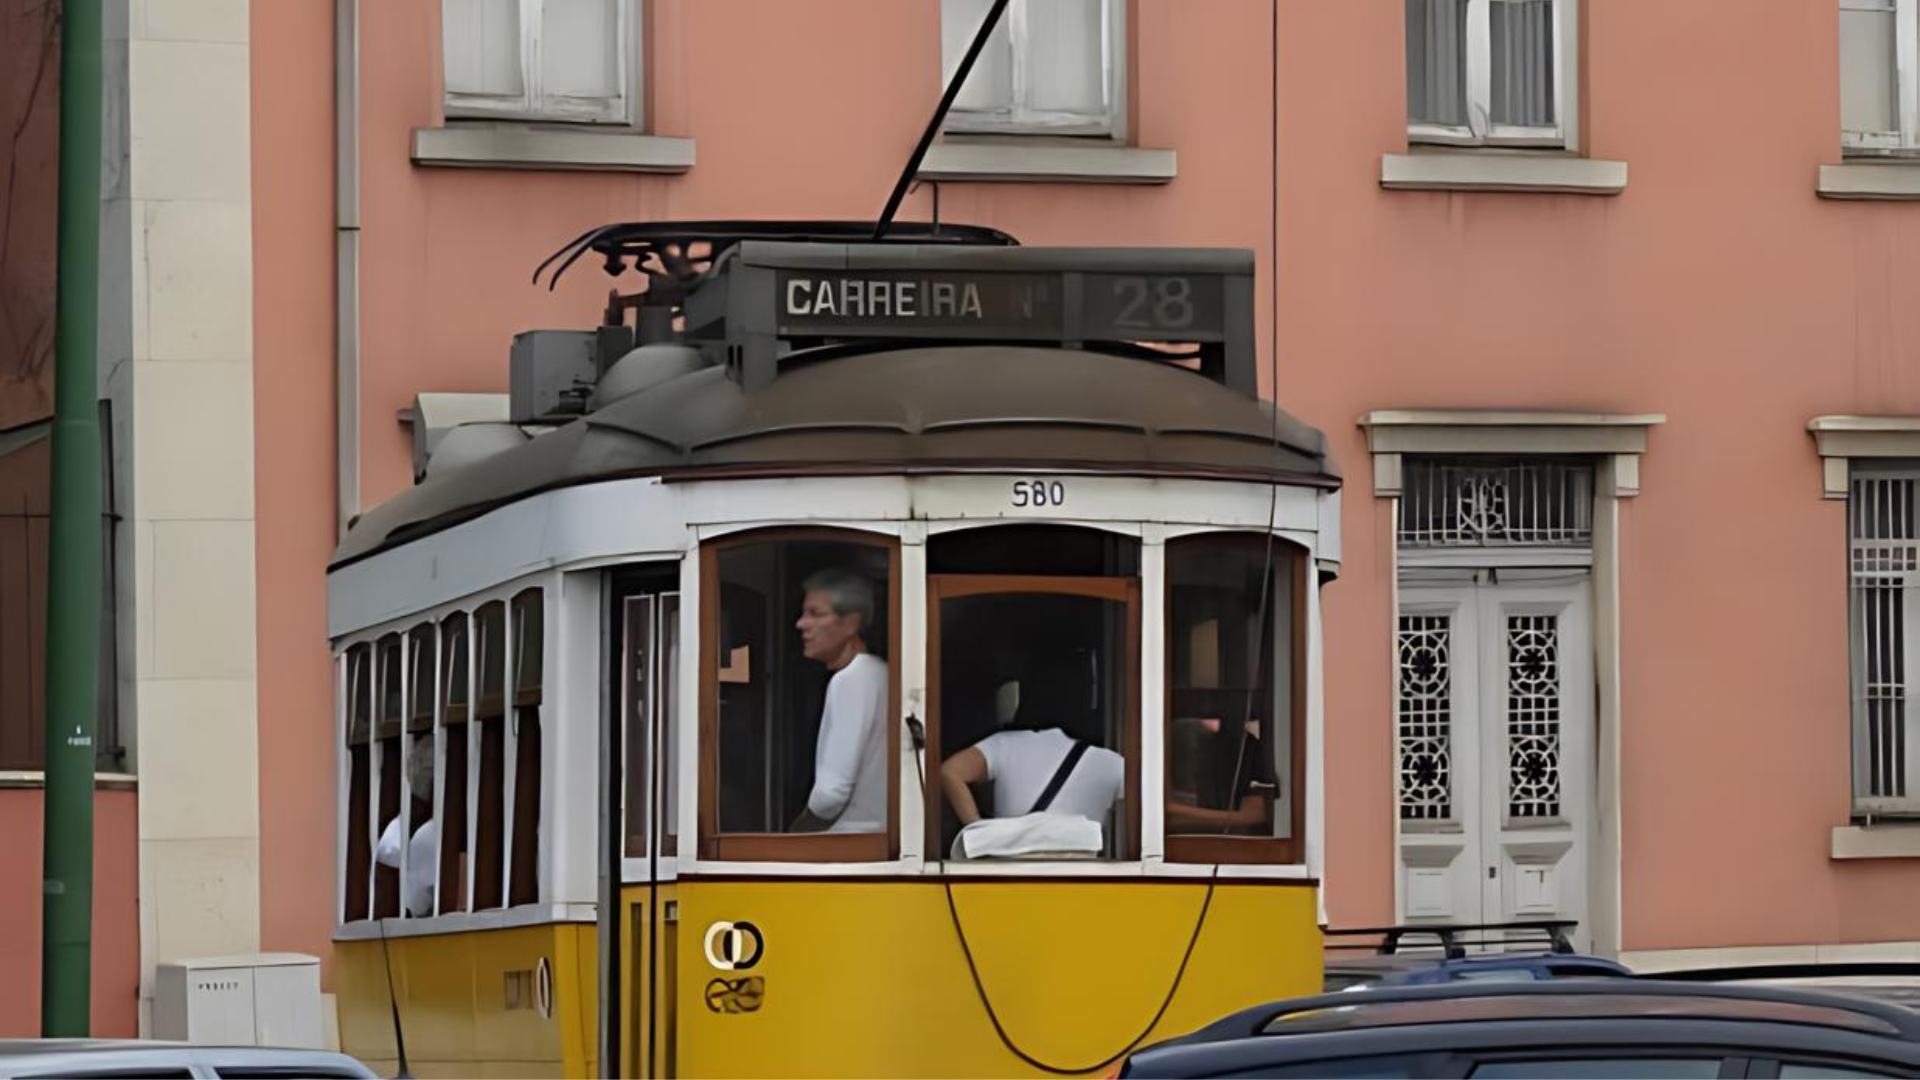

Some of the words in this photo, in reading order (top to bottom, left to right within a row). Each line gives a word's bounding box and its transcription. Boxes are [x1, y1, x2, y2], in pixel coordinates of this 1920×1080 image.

[786, 278, 983, 319] CARREIRA
[1112, 276, 1195, 328] 28
[1011, 480, 1065, 507] 580
